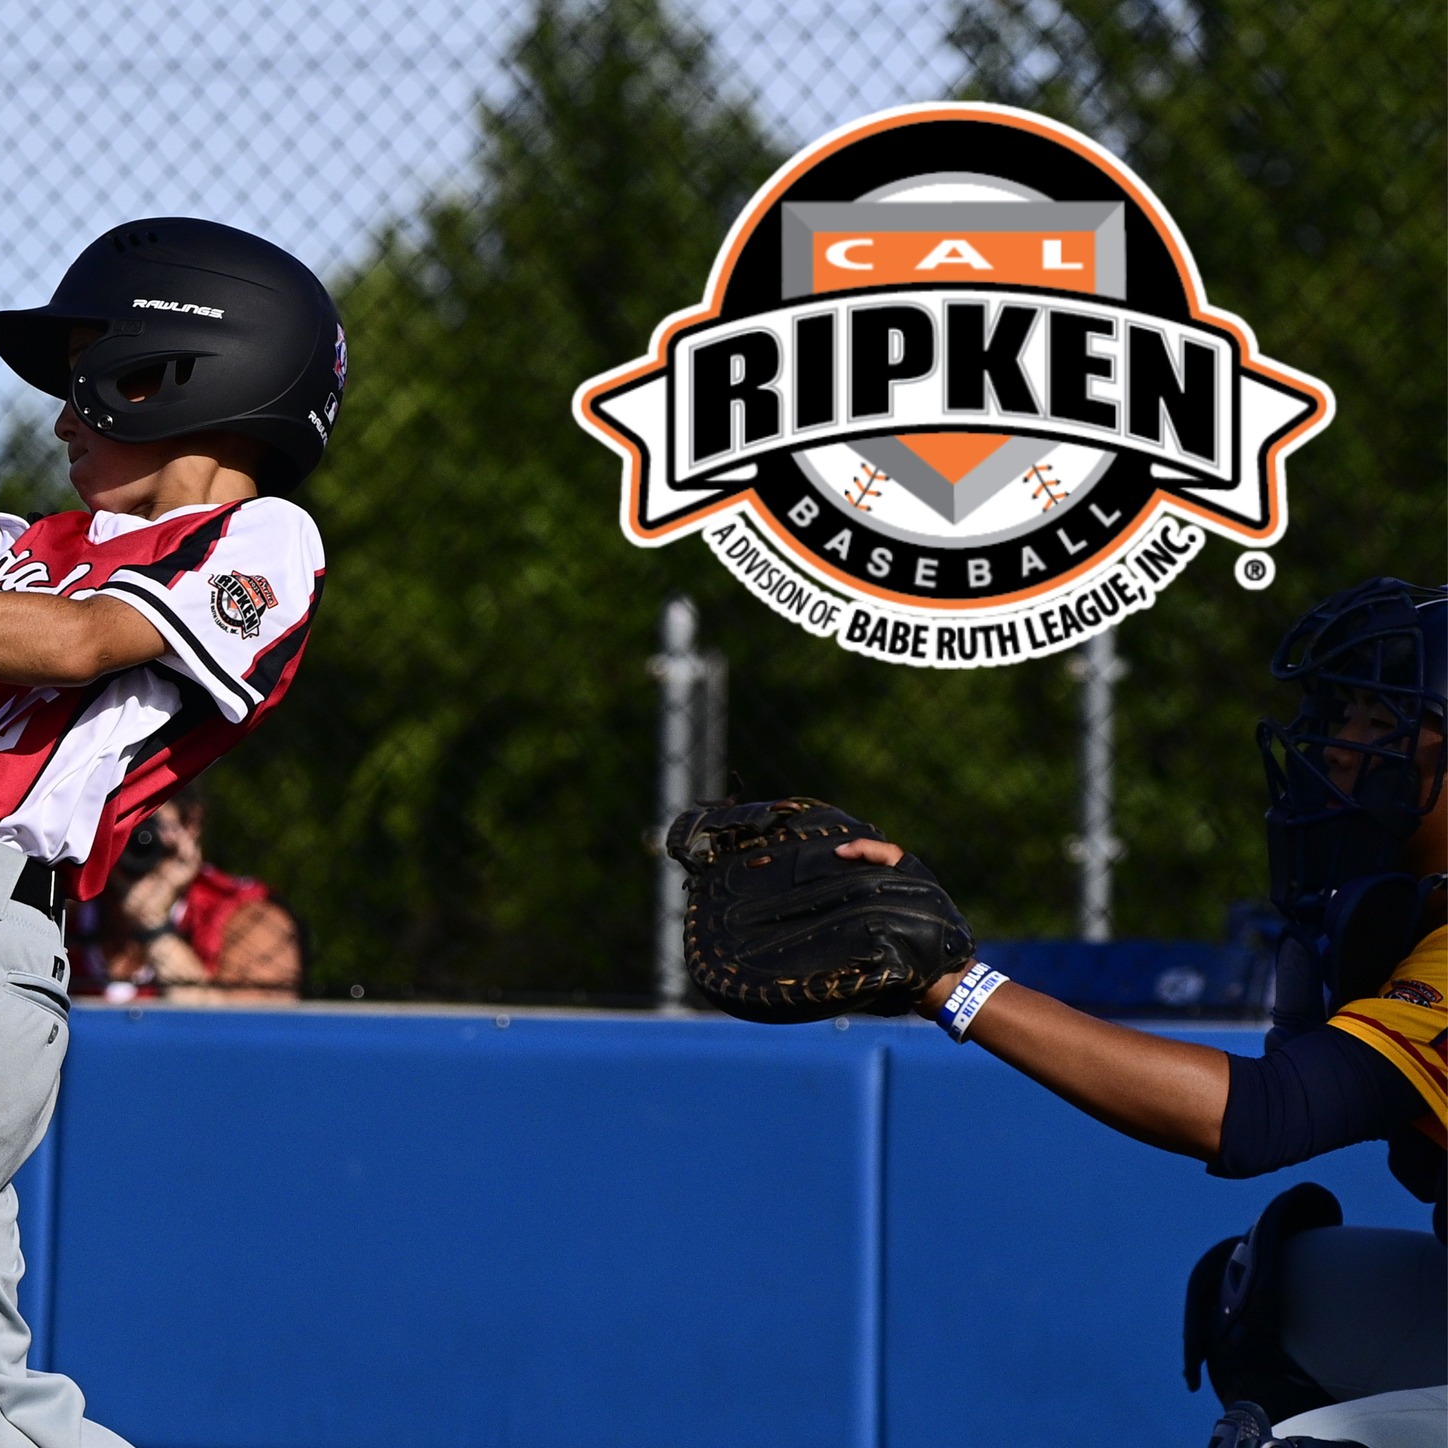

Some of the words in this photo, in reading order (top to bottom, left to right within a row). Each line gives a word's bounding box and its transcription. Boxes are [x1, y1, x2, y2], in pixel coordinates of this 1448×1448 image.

[132, 299, 225, 319] RAWLINGS
[217, 575, 258, 630] RIPKEN
[944, 985, 971, 1013] BIG
[962, 997, 980, 1018] HIT
[980, 977, 999, 992] RUN
